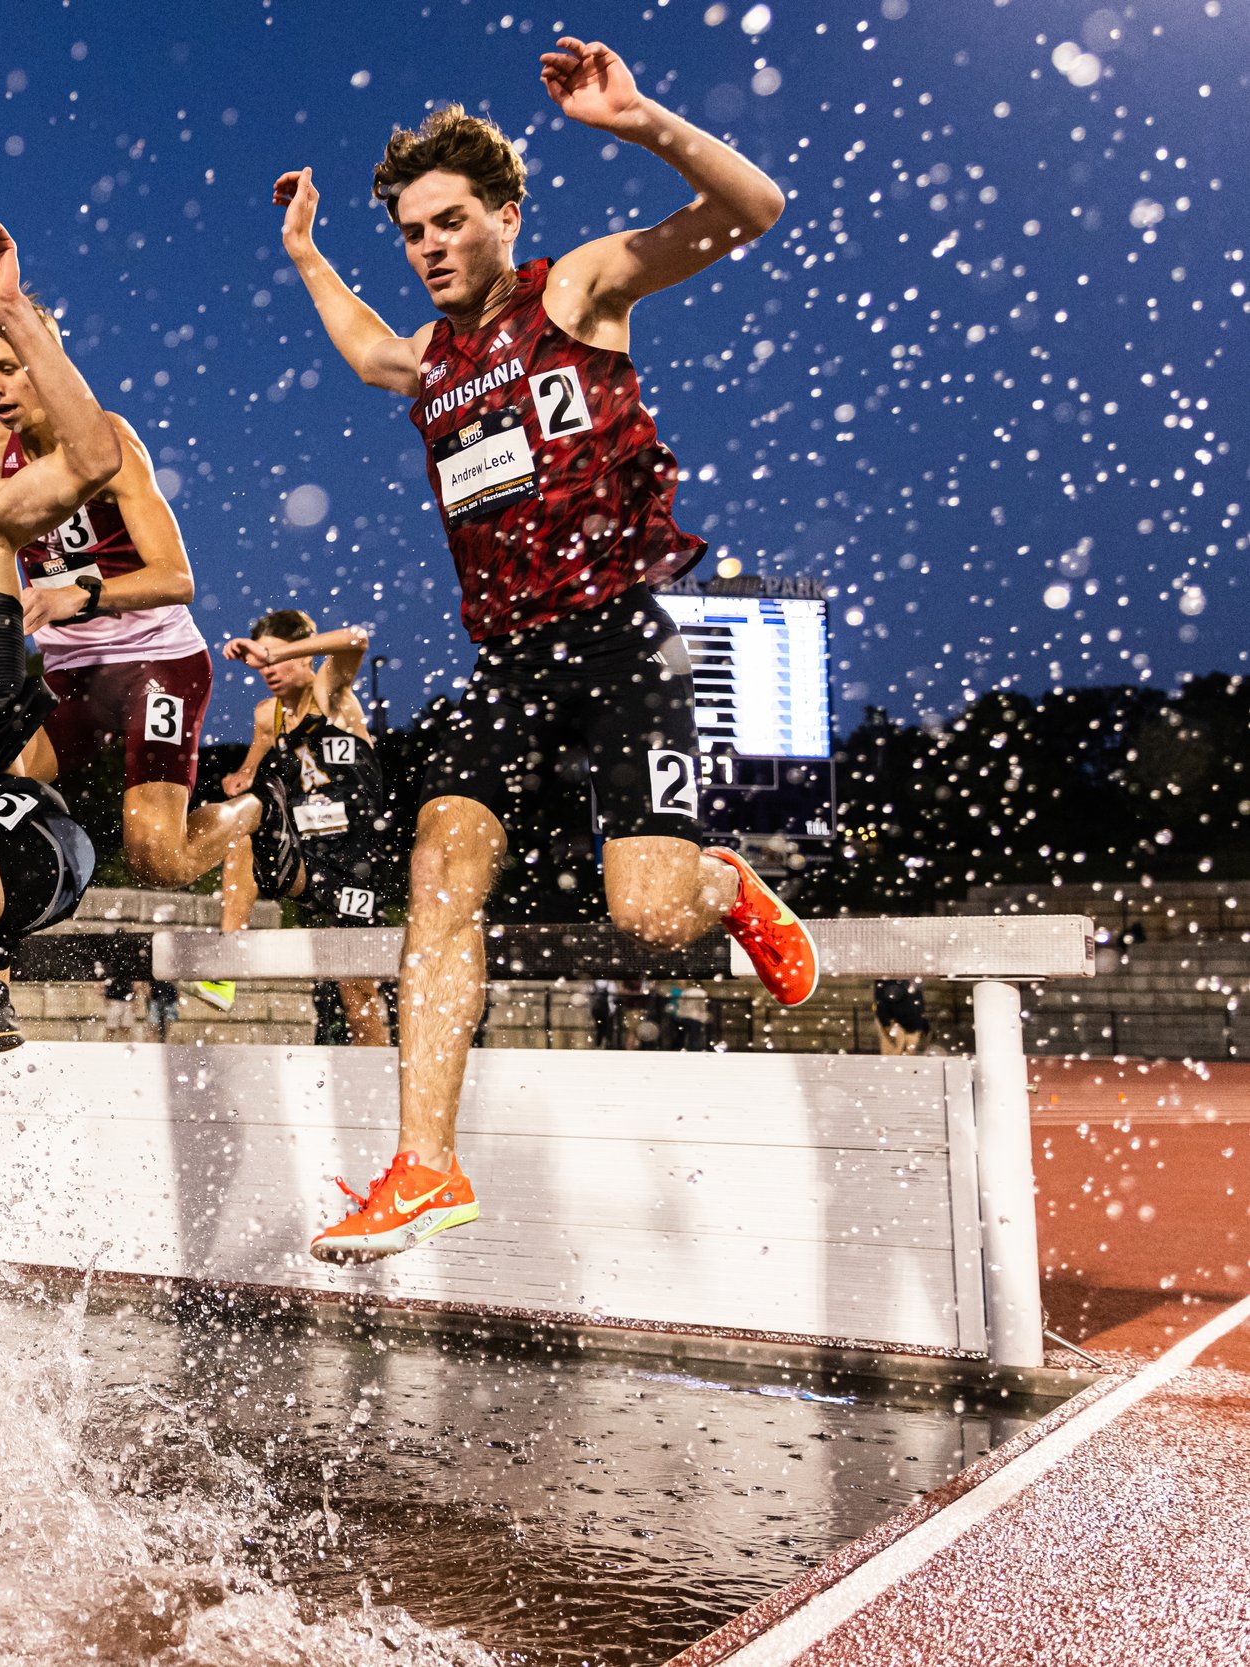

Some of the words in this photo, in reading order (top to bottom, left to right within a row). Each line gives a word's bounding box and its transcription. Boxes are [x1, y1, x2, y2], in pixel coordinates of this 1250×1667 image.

[424, 357, 525, 426] LOUISIANA
[539, 373, 584, 435] 2
[458, 420, 484, 448] SBC
[451, 463, 483, 487] Andrew
[484, 450, 516, 471] Leck
[64, 511, 90, 549] 3
[42, 557, 69, 576] SBC
[764, 576, 826, 598] PARK
[151, 697, 177, 739] 3
[293, 744, 332, 793] A
[324, 738, 350, 762] 12
[656, 754, 693, 812] 2
[345, 890, 368, 915] 12
